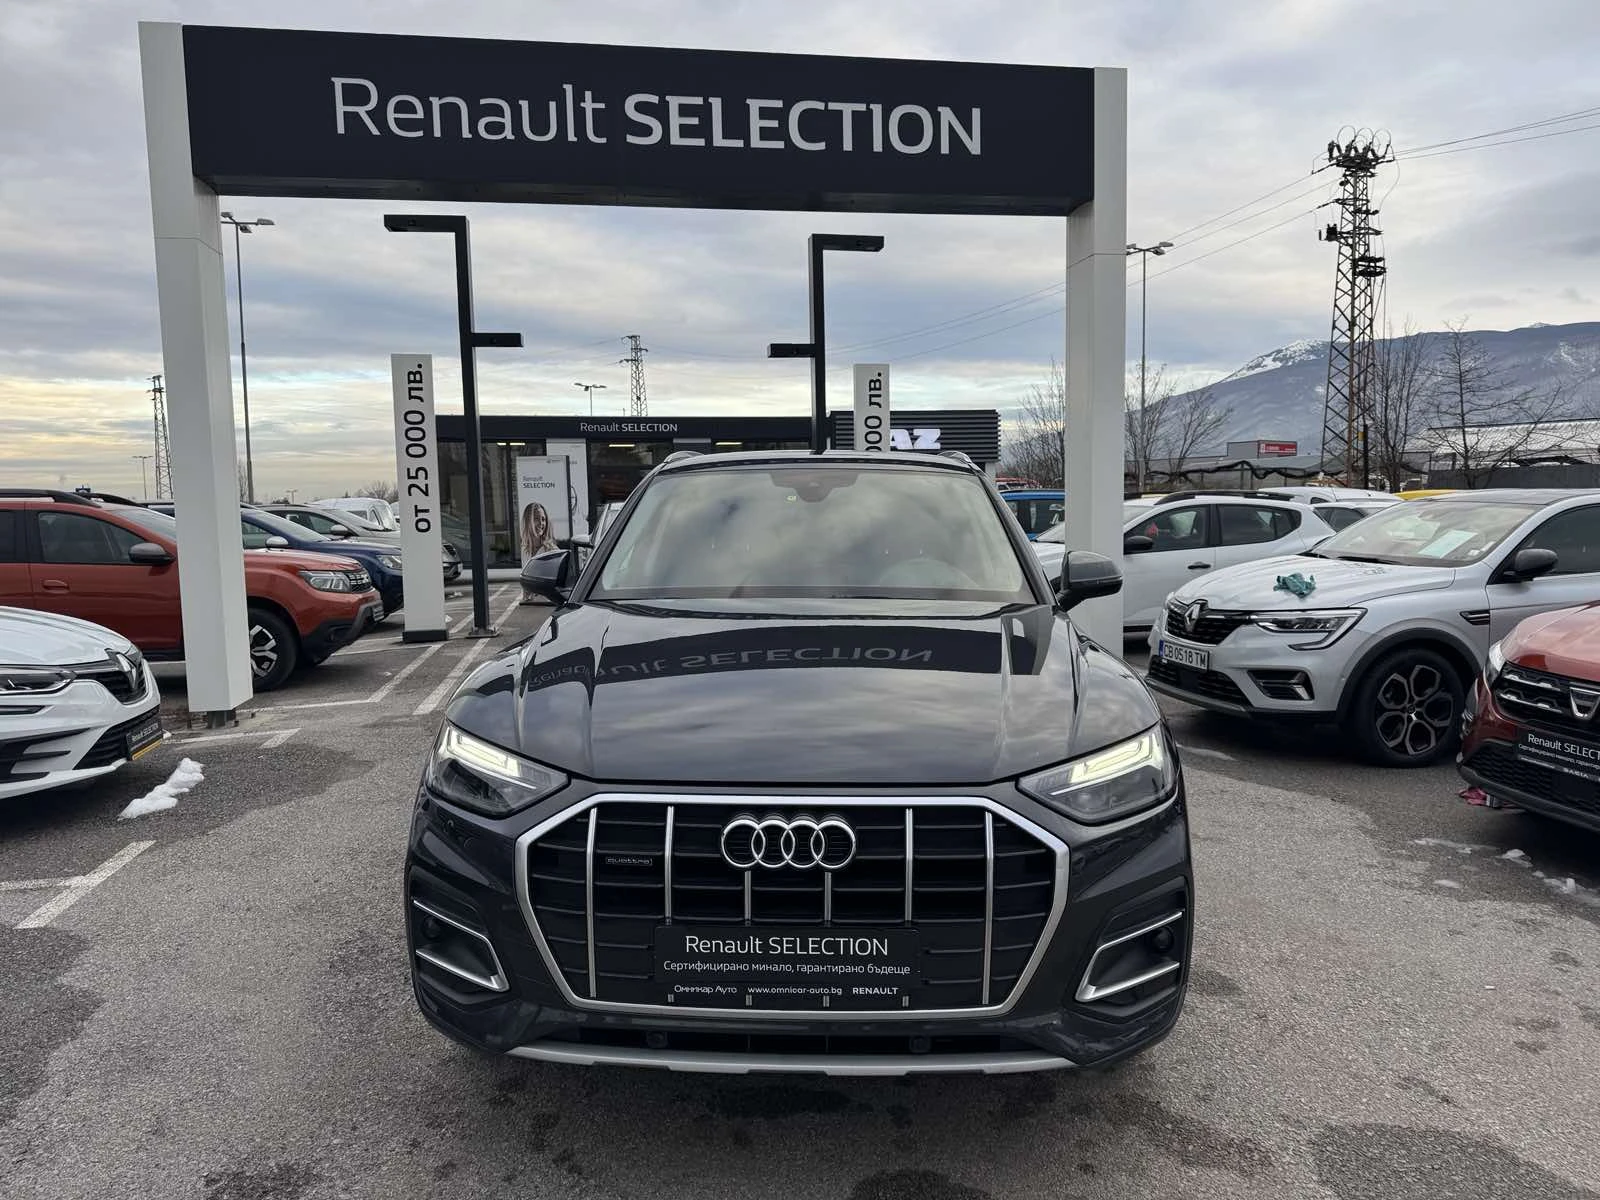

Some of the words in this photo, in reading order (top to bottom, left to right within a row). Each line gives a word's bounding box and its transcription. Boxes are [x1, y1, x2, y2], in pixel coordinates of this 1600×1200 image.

[331, 77, 607, 144] Renault
[624, 94, 982, 156] SELECTION
[407, 363, 425, 403] лв.
[868, 372, 882, 408] лв.
[403, 410, 427, 459] 000
[580, 422, 620, 432] Renault
[621, 423, 678, 432] SELECTION
[407, 466, 429, 497] 25
[414, 504, 432, 533] от
[1174, 647, 1194, 664] 0518
[1194, 652, 1206, 667] TM
[1527, 733, 1562, 751] Renault
[685, 935, 763, 955] Renault
[768, 937, 888, 956] SELECTION
[663, 960, 750, 973] Сертифицирано
[751, 964, 795, 973] минало,
[796, 964, 866, 975] гарантирано
[867, 964, 911, 975] бъдеще
[674, 984, 714, 993] Омникар
[715, 985, 738, 994] Ауто
[852, 987, 899, 995] RENAULT
